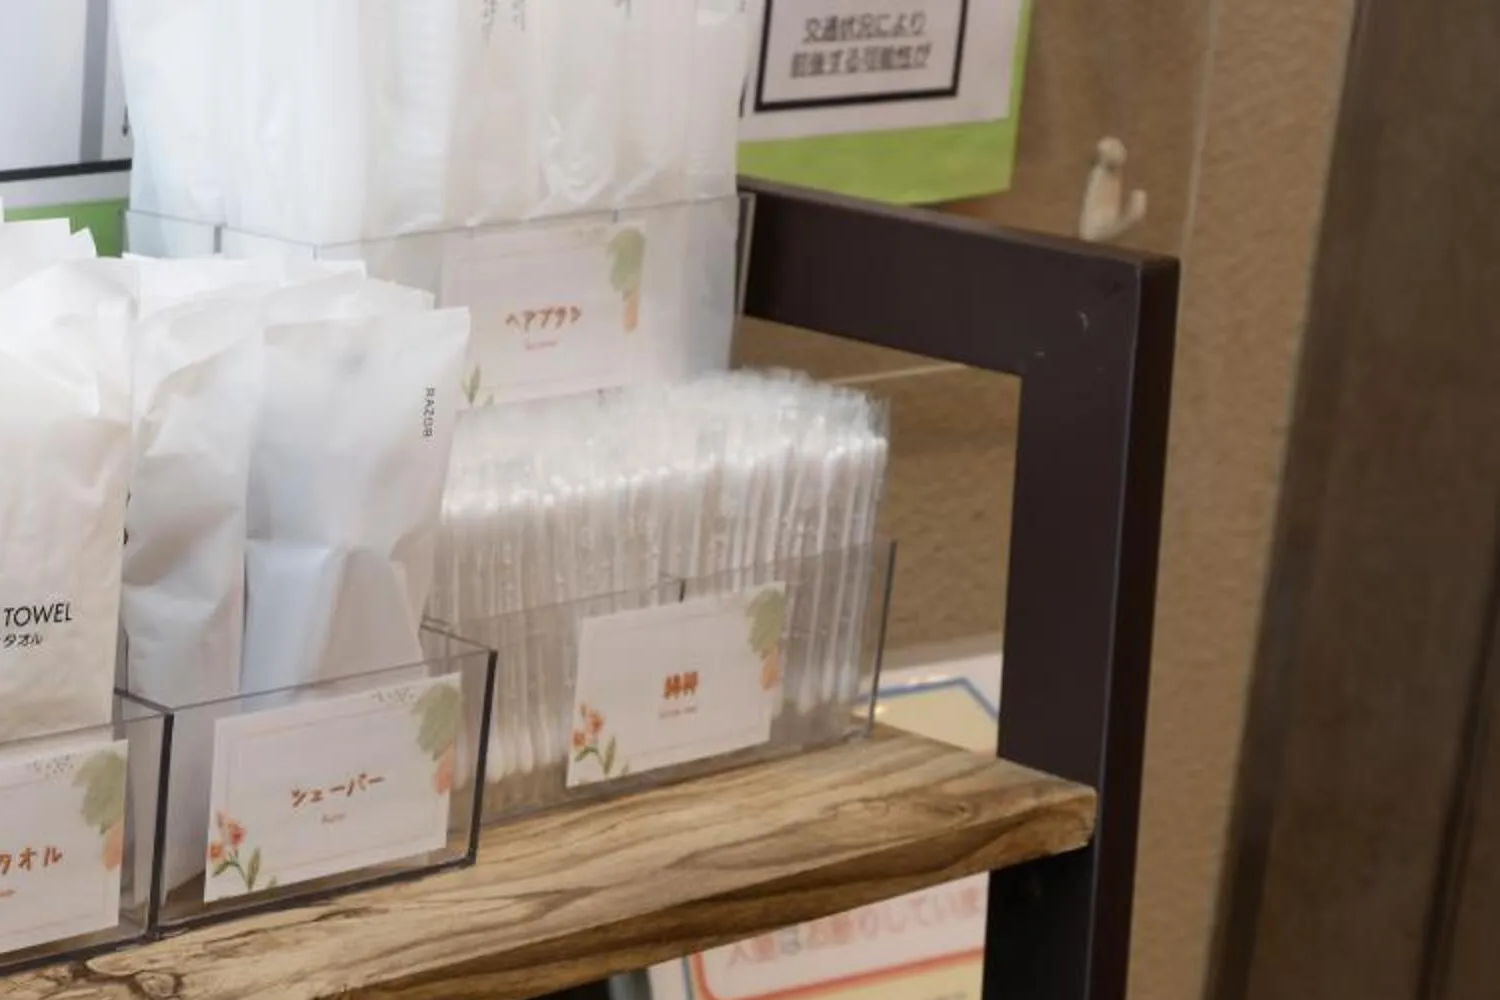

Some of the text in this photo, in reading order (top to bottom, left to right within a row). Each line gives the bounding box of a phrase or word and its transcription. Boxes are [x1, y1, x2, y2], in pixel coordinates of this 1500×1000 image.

[802, 10, 928, 44] 交通状況により
[789, 41, 933, 79] 前後する可能性が
[3, 602, 73, 628] TOWEL
[291, 772, 385, 808] シェーバー
